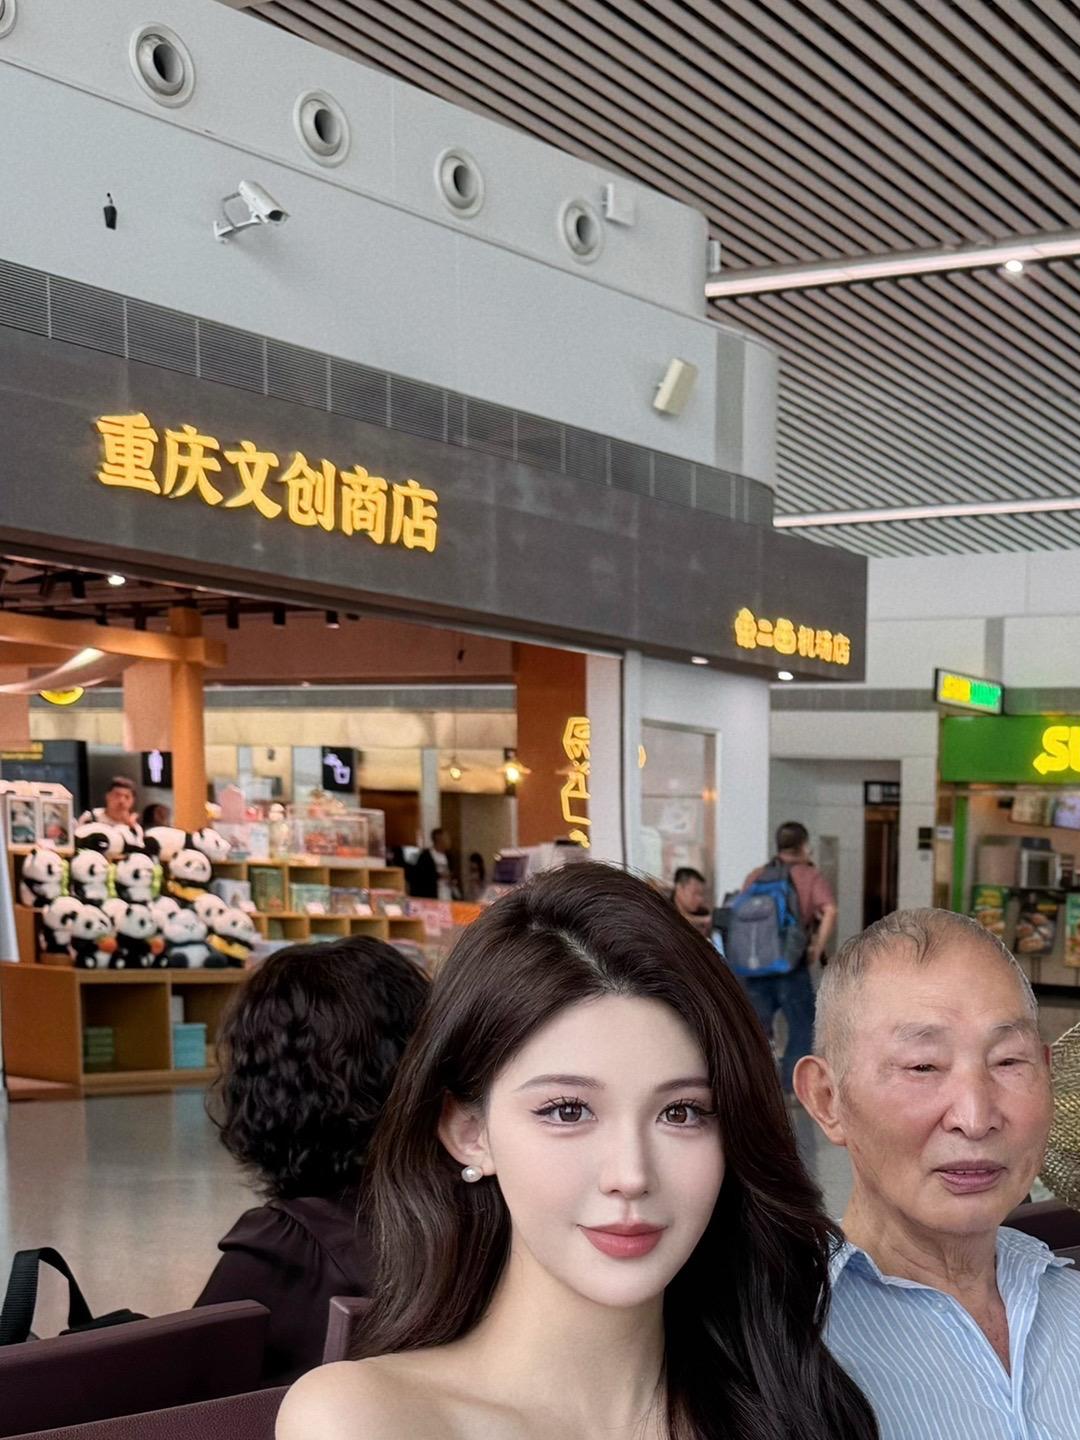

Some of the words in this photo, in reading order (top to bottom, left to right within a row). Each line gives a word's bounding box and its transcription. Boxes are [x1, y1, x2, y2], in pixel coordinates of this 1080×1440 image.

[96, 412, 439, 552] 重庆文创商店
